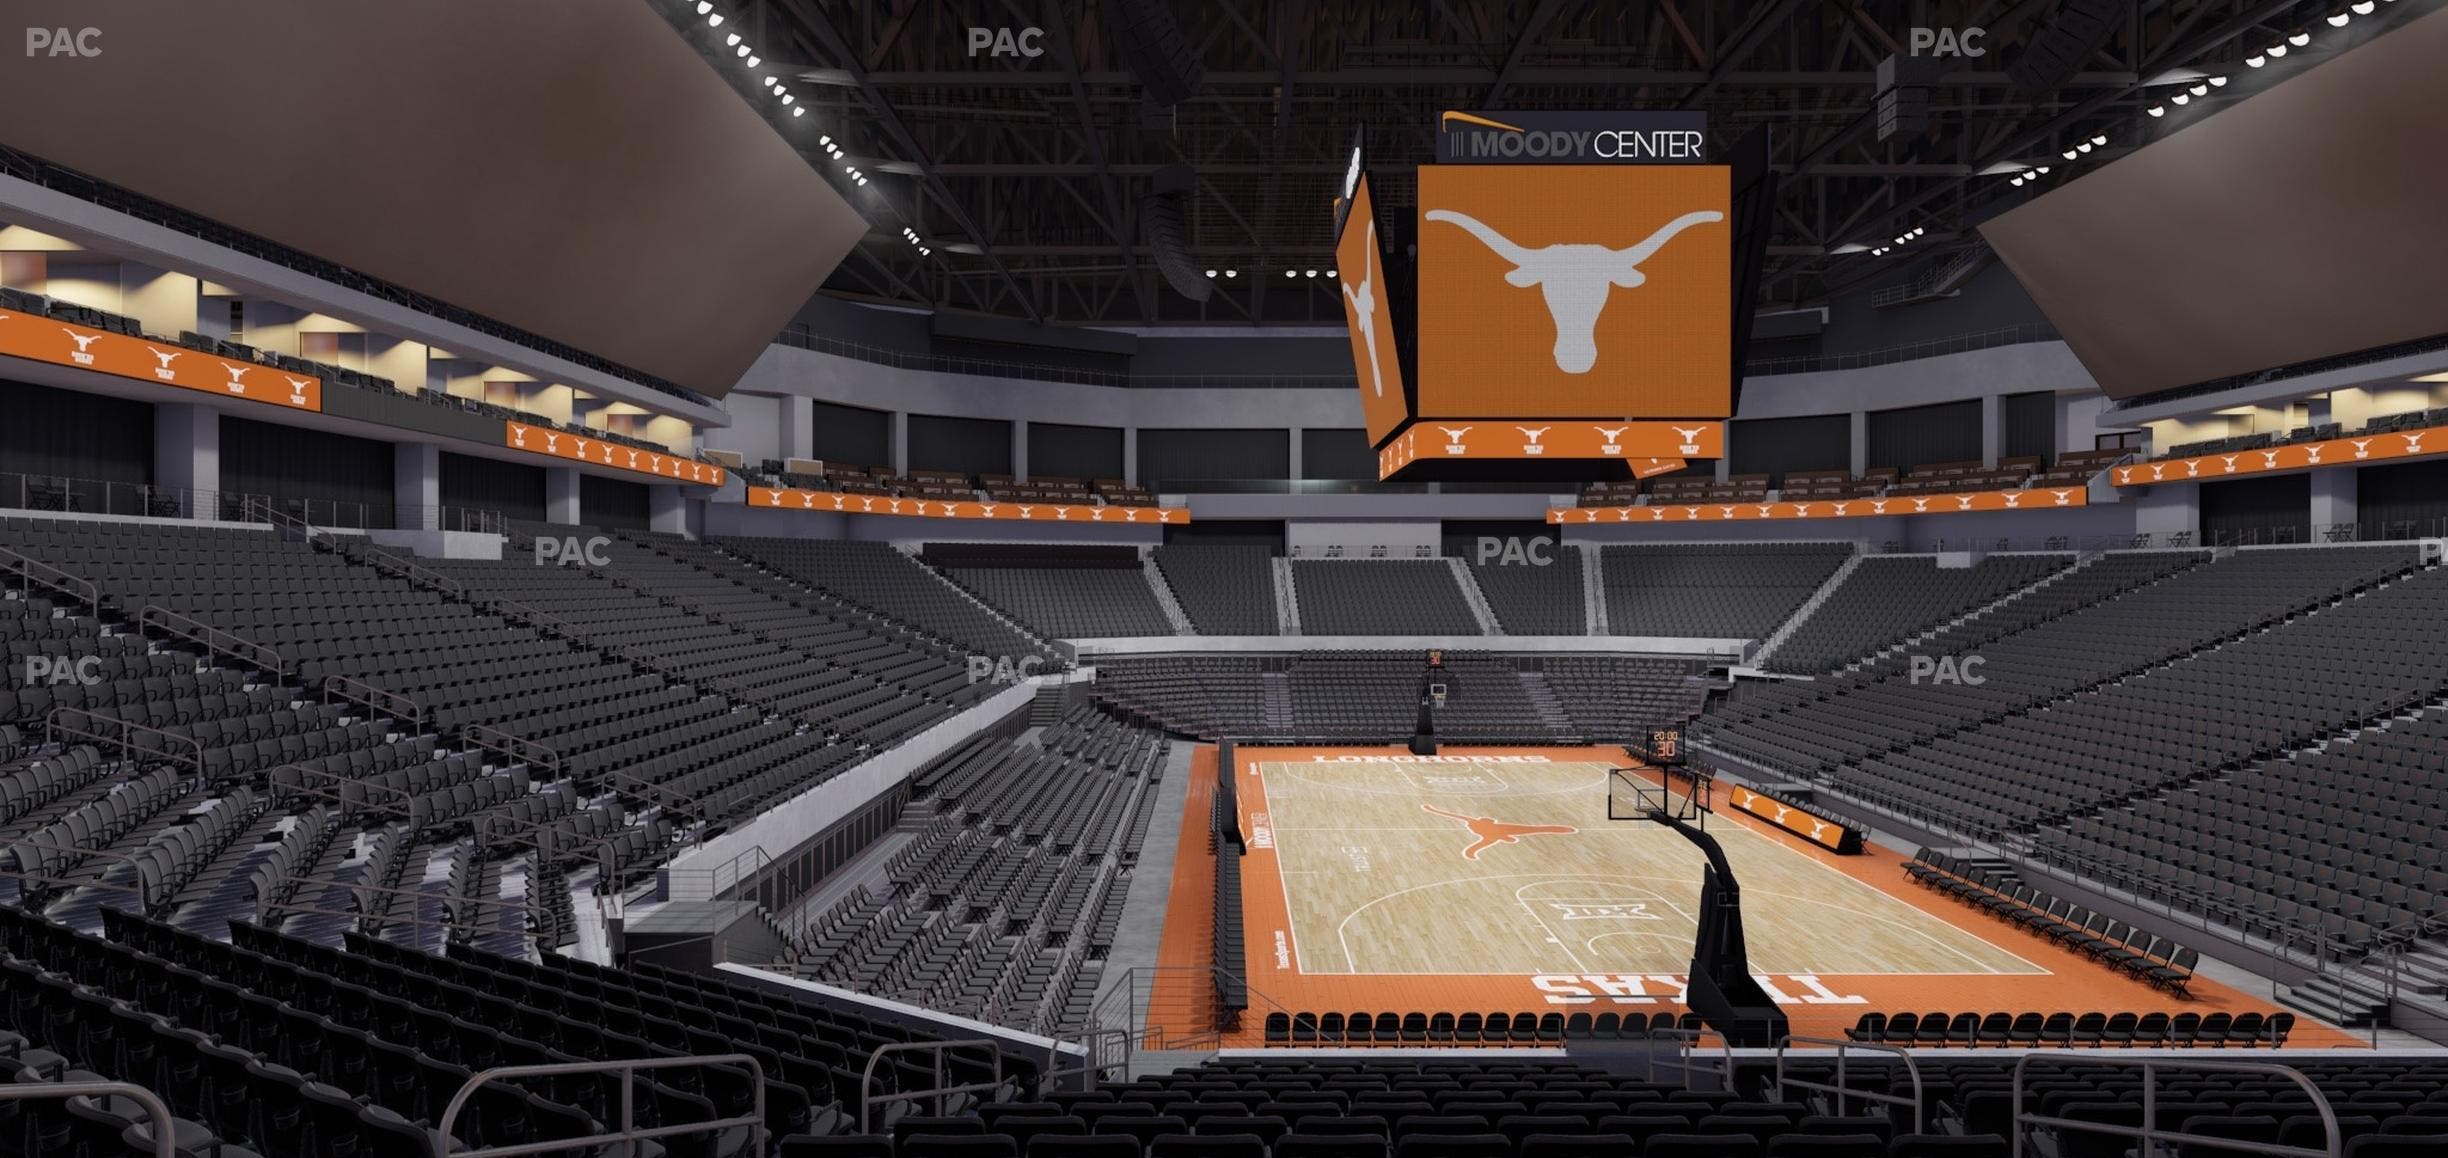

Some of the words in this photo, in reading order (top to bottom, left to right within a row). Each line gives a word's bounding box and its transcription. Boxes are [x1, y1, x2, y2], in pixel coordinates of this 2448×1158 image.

[1471, 131, 1590, 157] MOODY
[1594, 131, 1703, 158] CENTER
[1654, 731, 1678, 741] 20:00
[1657, 741, 1675, 757] 30
